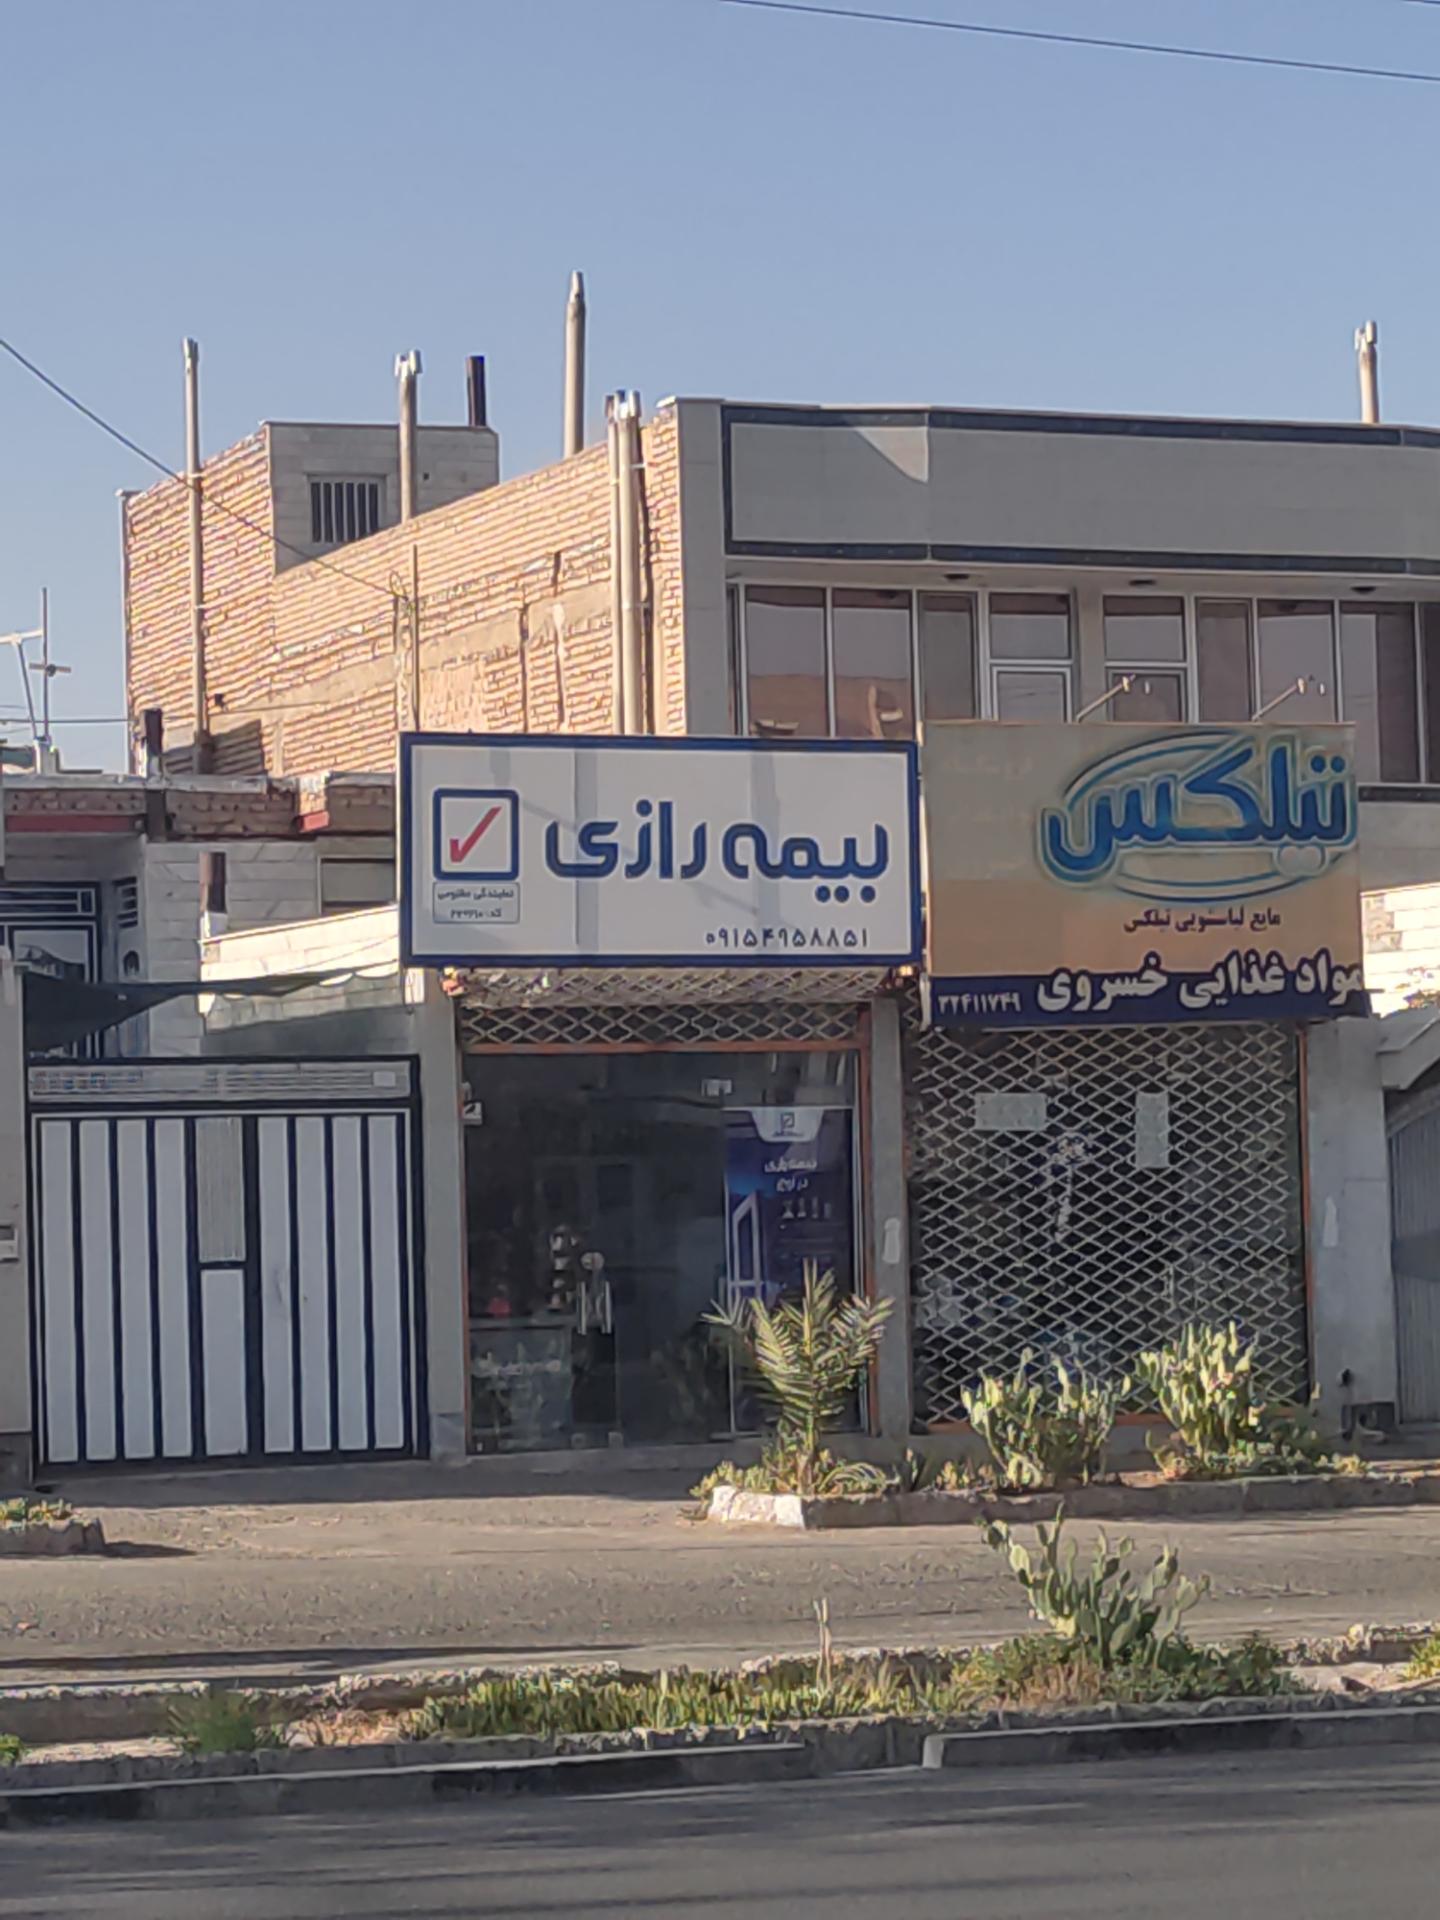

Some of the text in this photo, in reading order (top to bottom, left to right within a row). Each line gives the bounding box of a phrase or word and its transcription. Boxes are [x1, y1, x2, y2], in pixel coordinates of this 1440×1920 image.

[544, 799, 890, 903] بیمه رازی
[1250, 907, 1281, 932] مایع
[1036, 955, 1169, 1012] خسروی
[1179, 949, 1286, 1009] غذایی
[1295, 951, 1363, 1006] مواد
